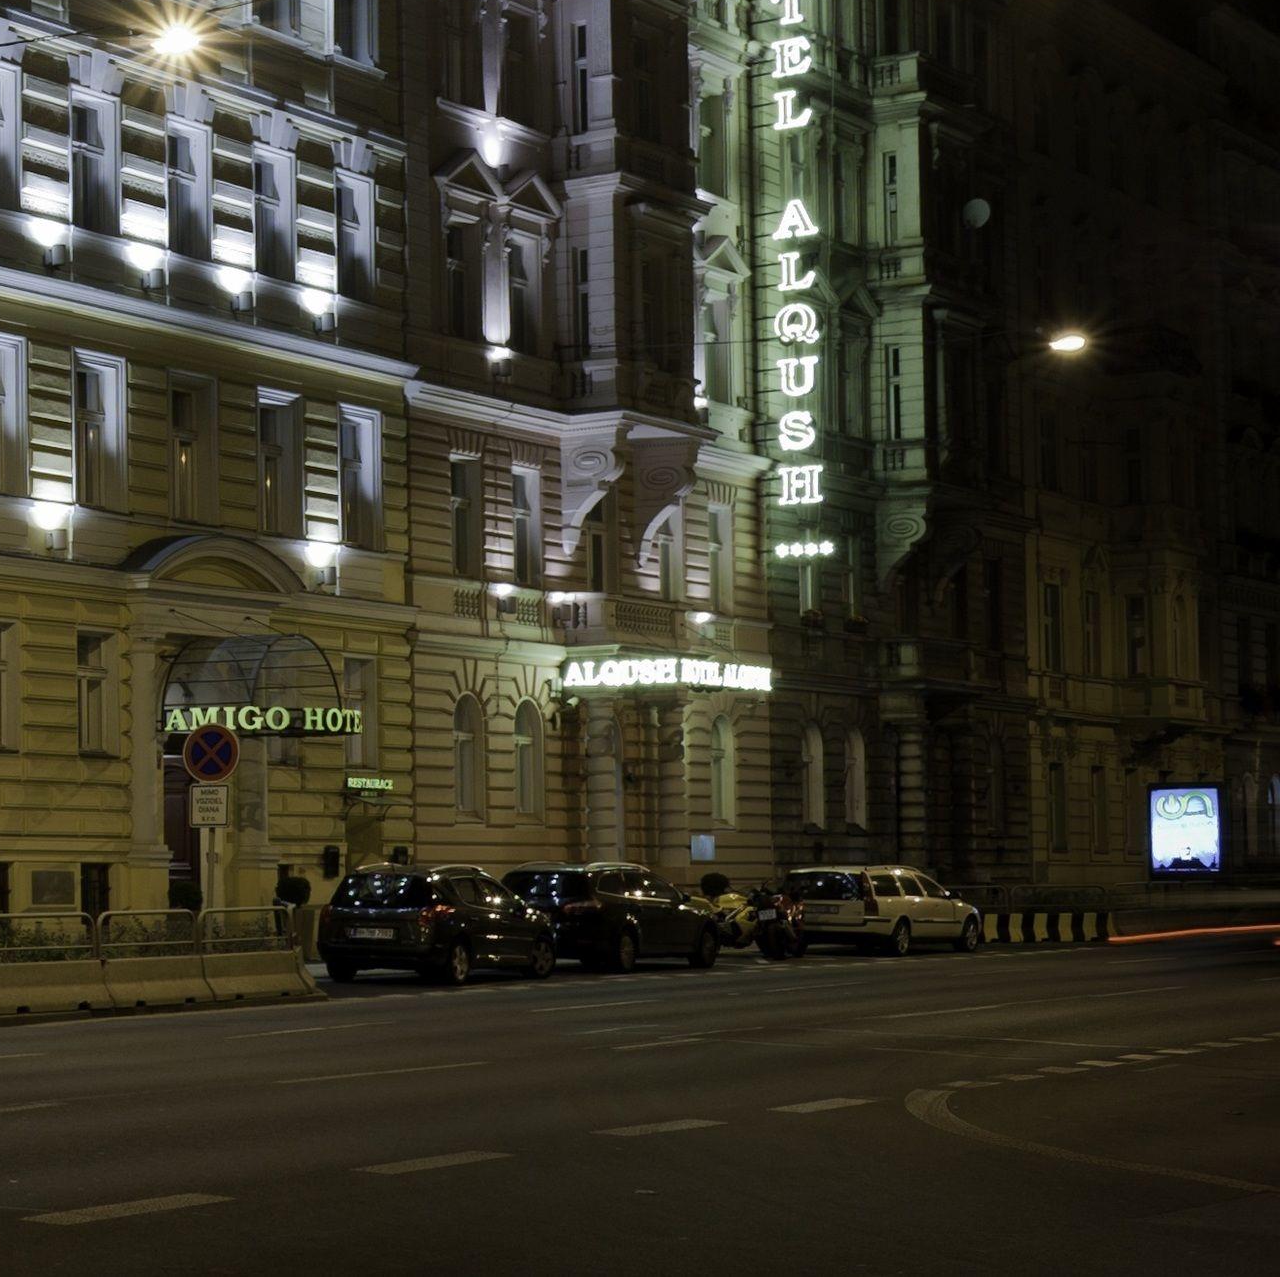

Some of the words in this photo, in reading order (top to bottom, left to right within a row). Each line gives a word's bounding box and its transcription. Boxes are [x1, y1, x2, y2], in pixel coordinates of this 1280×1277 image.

[772, 199, 824, 507] ALQUSH
[164, 705, 291, 733] AMIGO
[303, 706, 364, 735] HOTE
